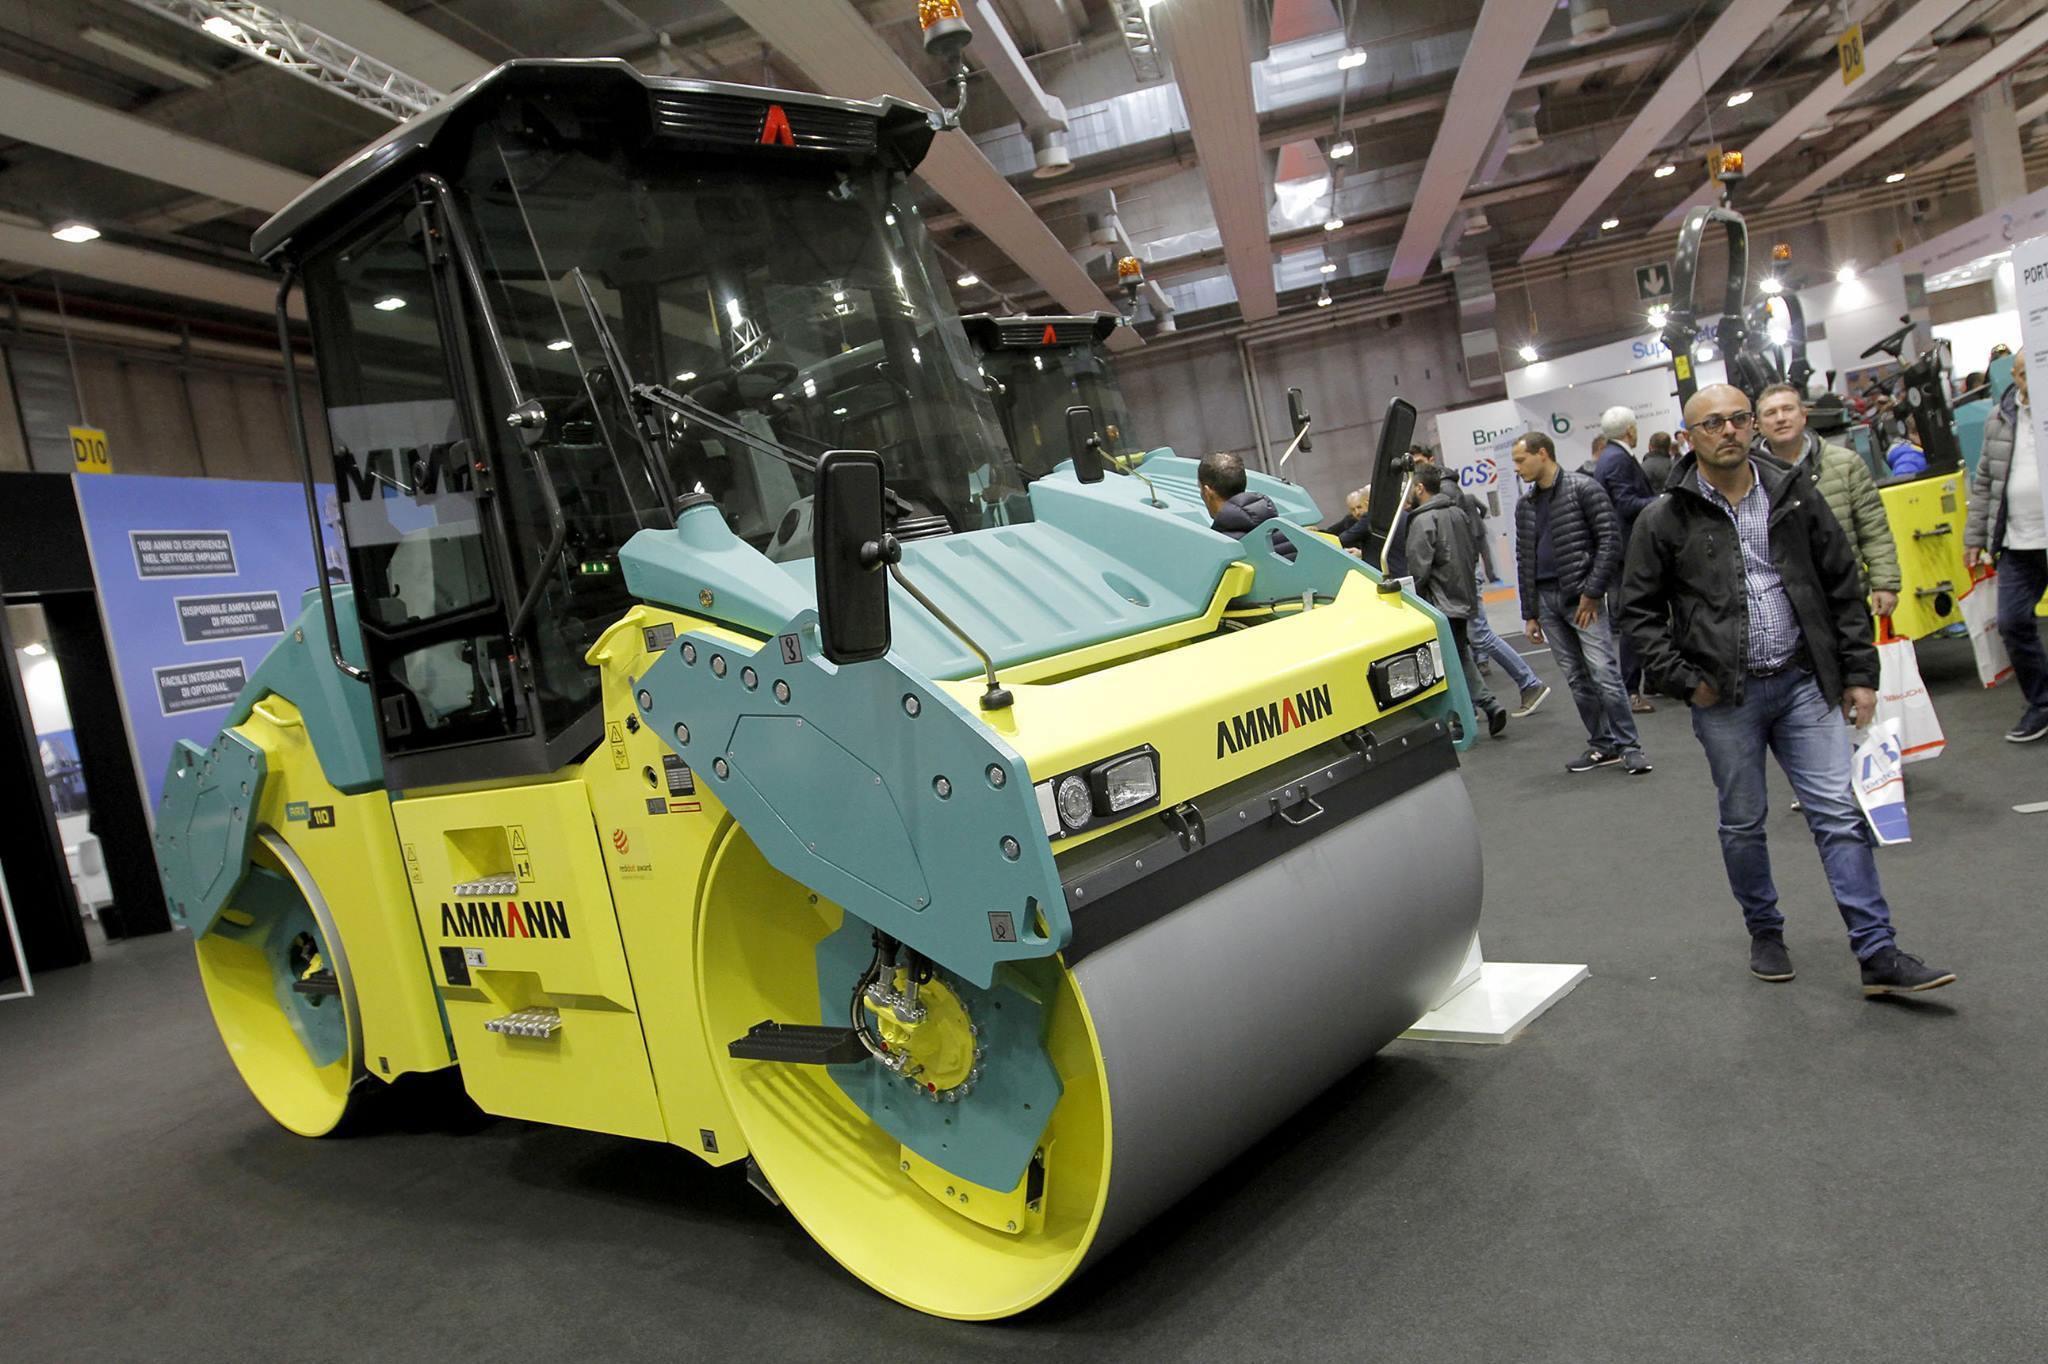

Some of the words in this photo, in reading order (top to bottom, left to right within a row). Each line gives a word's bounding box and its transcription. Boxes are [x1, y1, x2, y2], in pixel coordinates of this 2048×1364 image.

[73, 437, 108, 465] D10
[153, 540, 173, 551] ANNI
[173, 540, 182, 551] DI
[182, 539, 228, 551] ESPERIENZA
[142, 553, 160, 565] NEL
[160, 552, 195, 564] SETTORE
[195, 551, 228, 562] IMPIANTI
[181, 603, 228, 617] DISPONIBILE
[228, 602, 251, 613] AMPIA
[251, 600, 277, 611] GAMMA
[211, 616, 220, 627] DI
[220, 614, 256, 626] PRODOTTI
[160, 675, 188, 687] FACILE
[188, 667, 241, 684] INTEGRAZIONE
[181, 687, 191, 698] DI
[191, 682, 229, 697] OPTIONAL
[1217, 683, 1333, 760] AMMANN
[313, 809, 330, 825] 110
[441, 900, 571, 938] AMMANN
